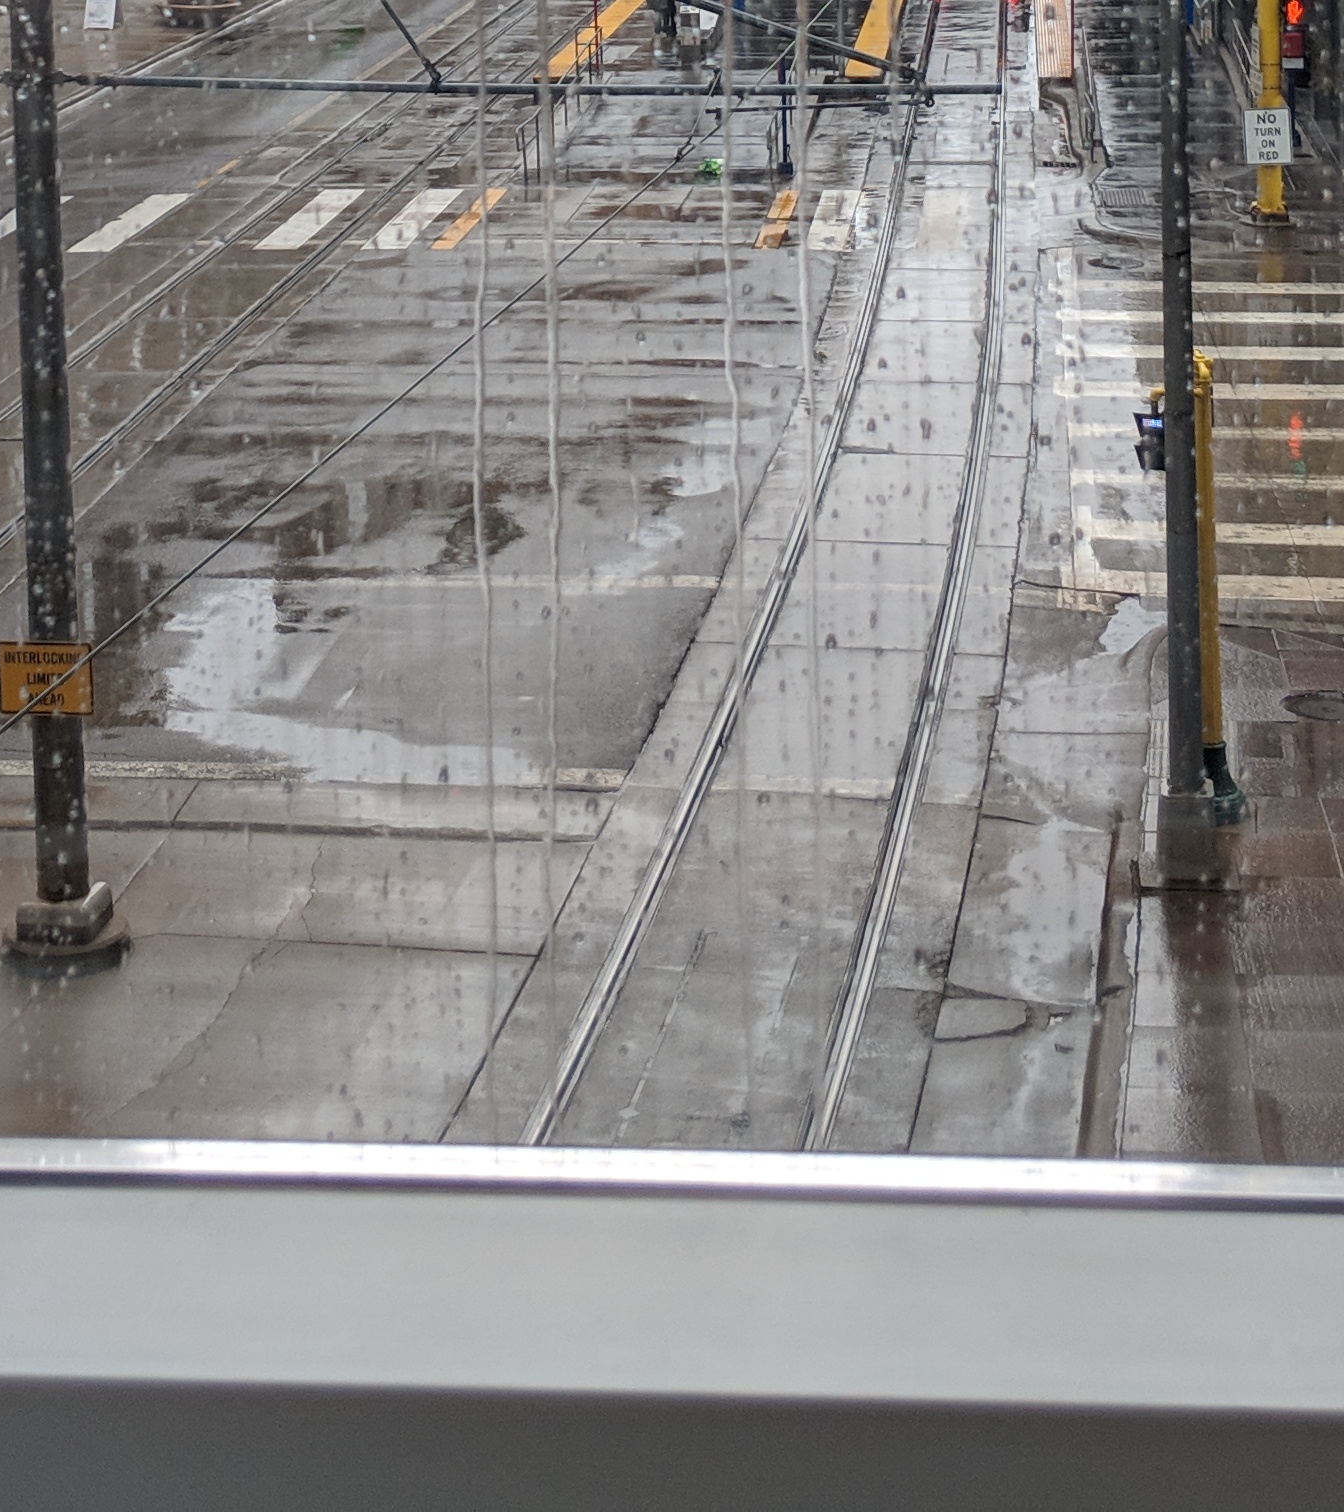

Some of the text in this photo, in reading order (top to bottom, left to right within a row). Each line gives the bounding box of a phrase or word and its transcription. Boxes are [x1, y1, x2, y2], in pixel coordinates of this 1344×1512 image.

[1256, 113, 1277, 125] NO
[1253, 126, 1282, 137] TURN
[1260, 139, 1276, 149] ON
[1258, 150, 1279, 161] RED
[4, 650, 83, 665] INTERLOCKIN
[28, 692, 65, 706] AEAD
